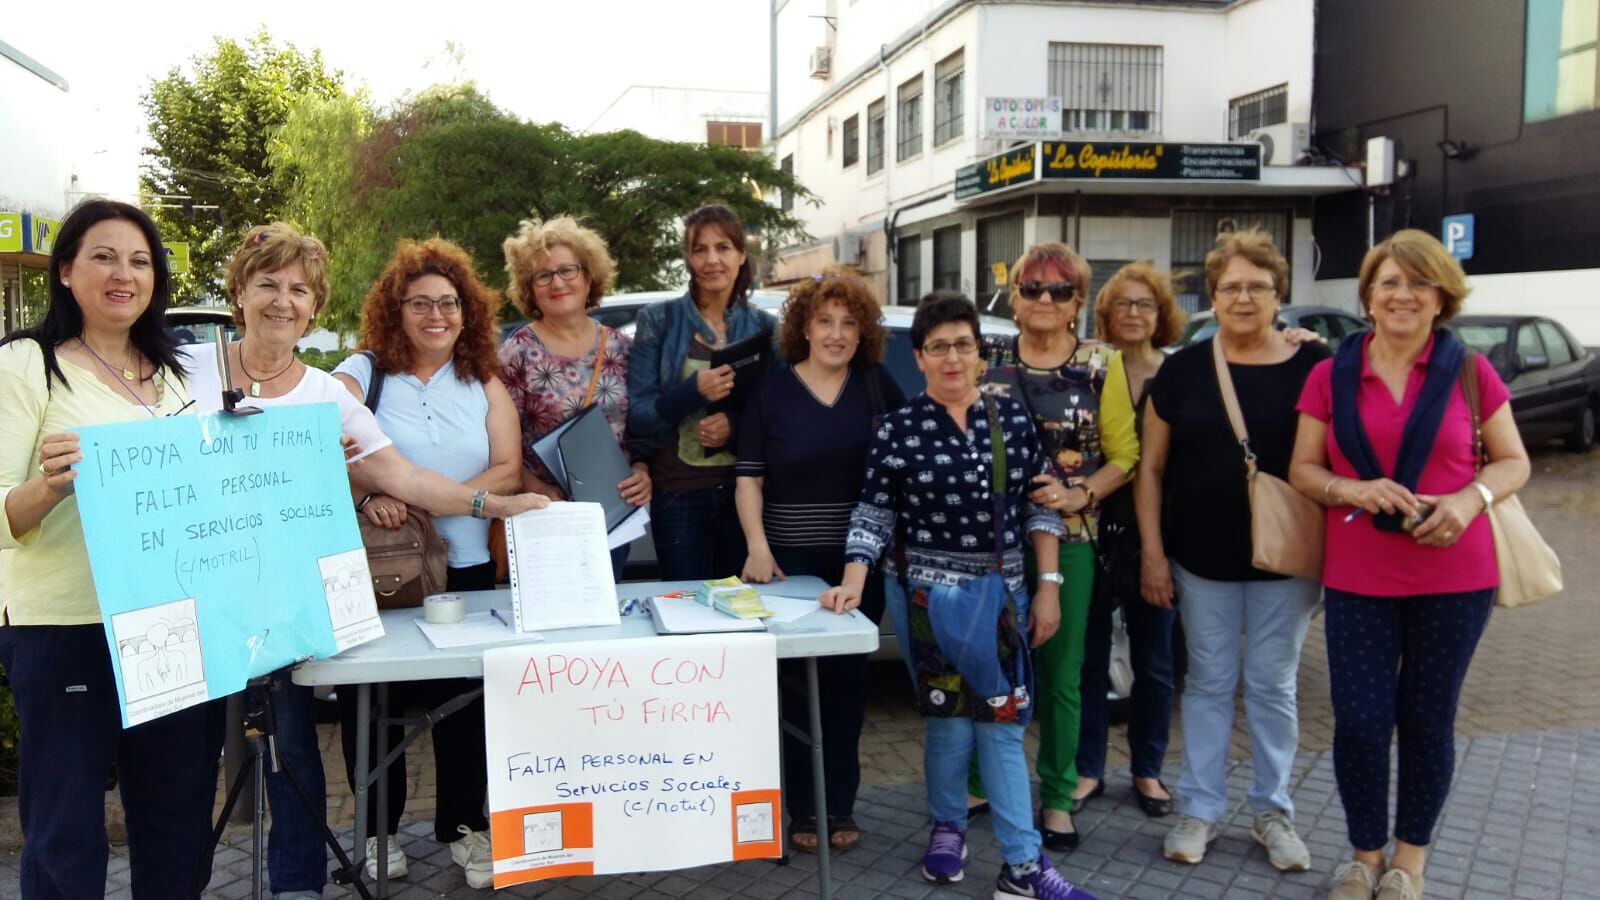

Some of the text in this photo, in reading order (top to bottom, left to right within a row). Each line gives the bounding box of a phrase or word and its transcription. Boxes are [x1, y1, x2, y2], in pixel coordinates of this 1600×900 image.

[998, 115, 1006, 129] A
[1447, 221, 1465, 254] P
[199, 436, 234, 456] CON
[243, 433, 259, 451] TU
[272, 415, 324, 454] FIRMA!
[135, 470, 293, 516] FALTA PERSONAL
[141, 503, 334, 552] EN SERVICIOS SOCIALES
[516, 645, 728, 696] APOYA CON
[642, 697, 732, 724] FIRMA
[506, 751, 715, 782] FALTA PERSONAL EN
[555, 775, 742, 798] Servicios Sociales
